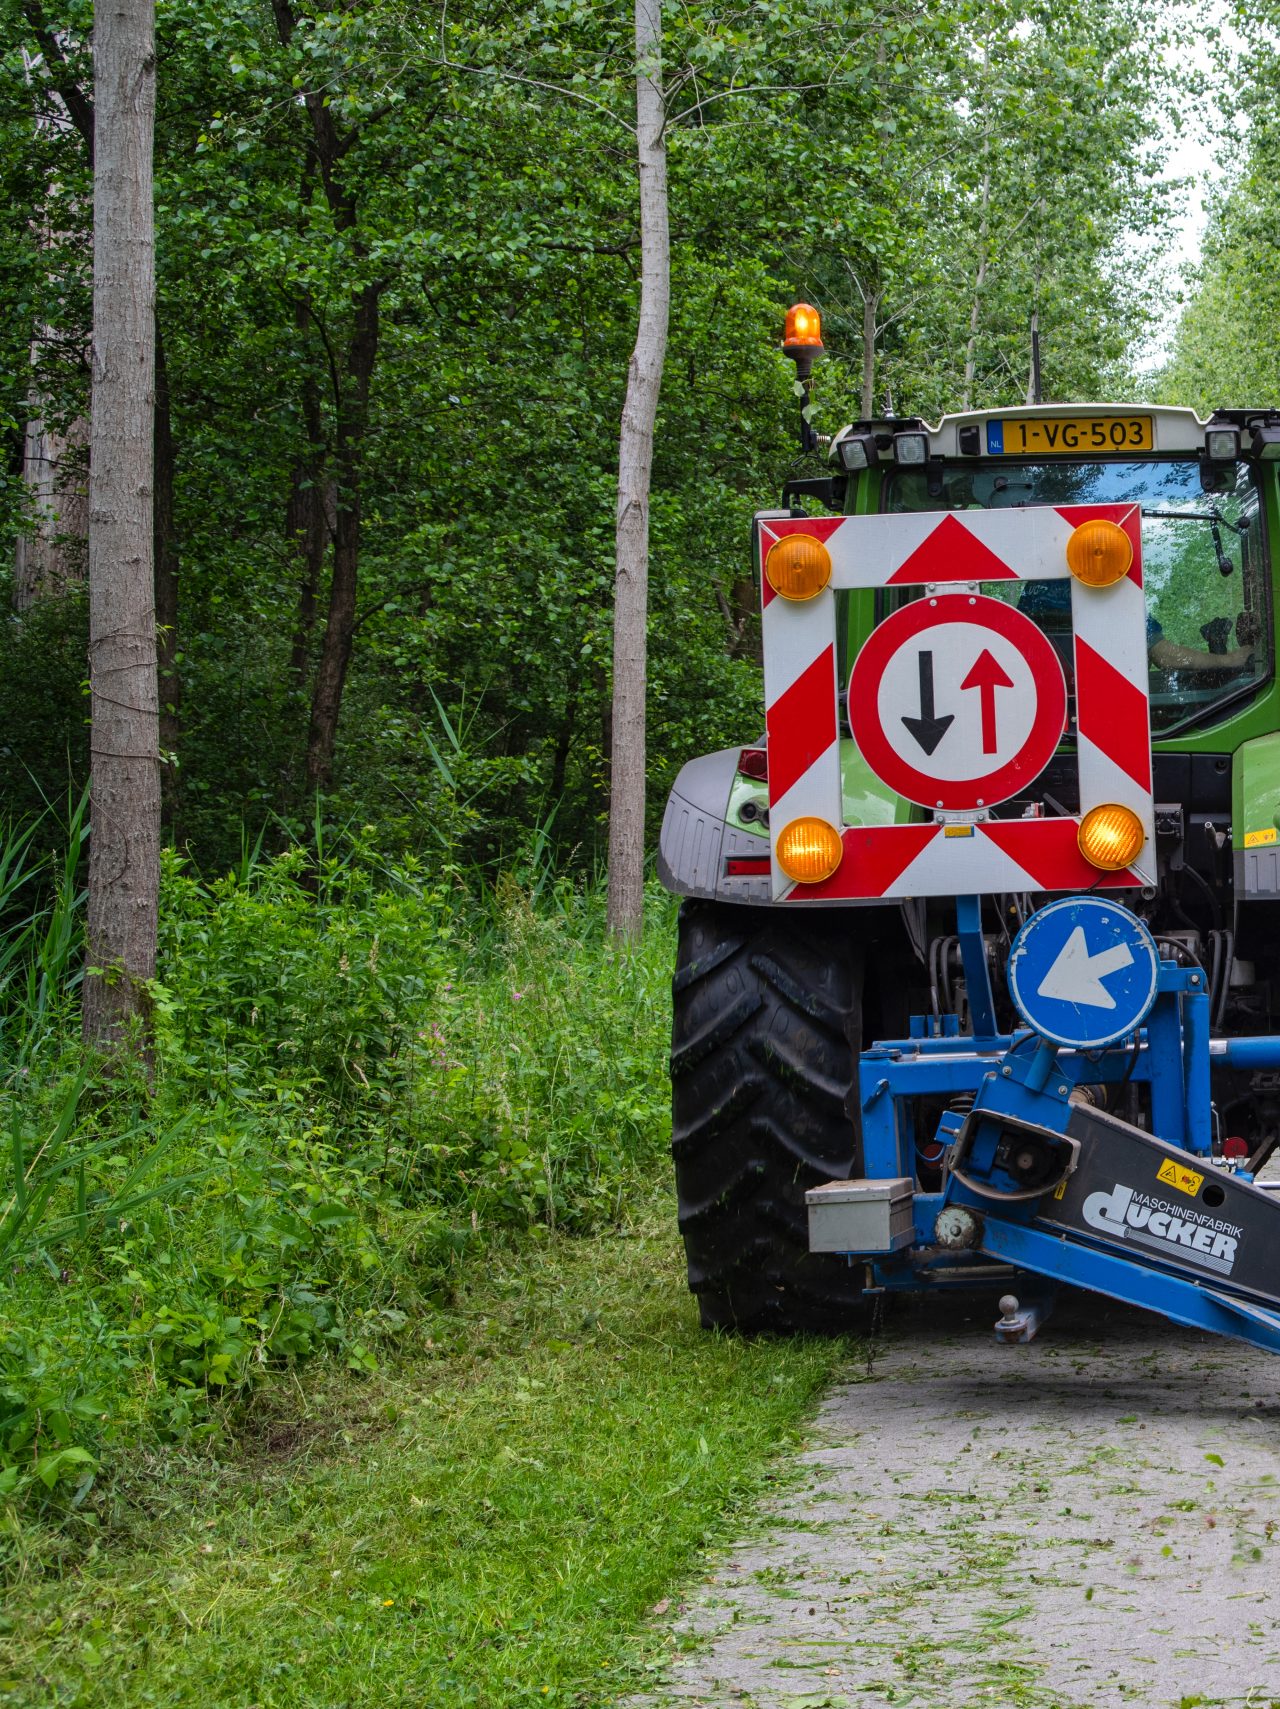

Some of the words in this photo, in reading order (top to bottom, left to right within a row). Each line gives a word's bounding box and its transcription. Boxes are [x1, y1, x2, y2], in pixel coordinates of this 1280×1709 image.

[990, 440, 1002, 449] NL
[1018, 421, 1144, 448] 1-VG-503
[1131, 1191, 1244, 1239] MASCHINENFABRIK
